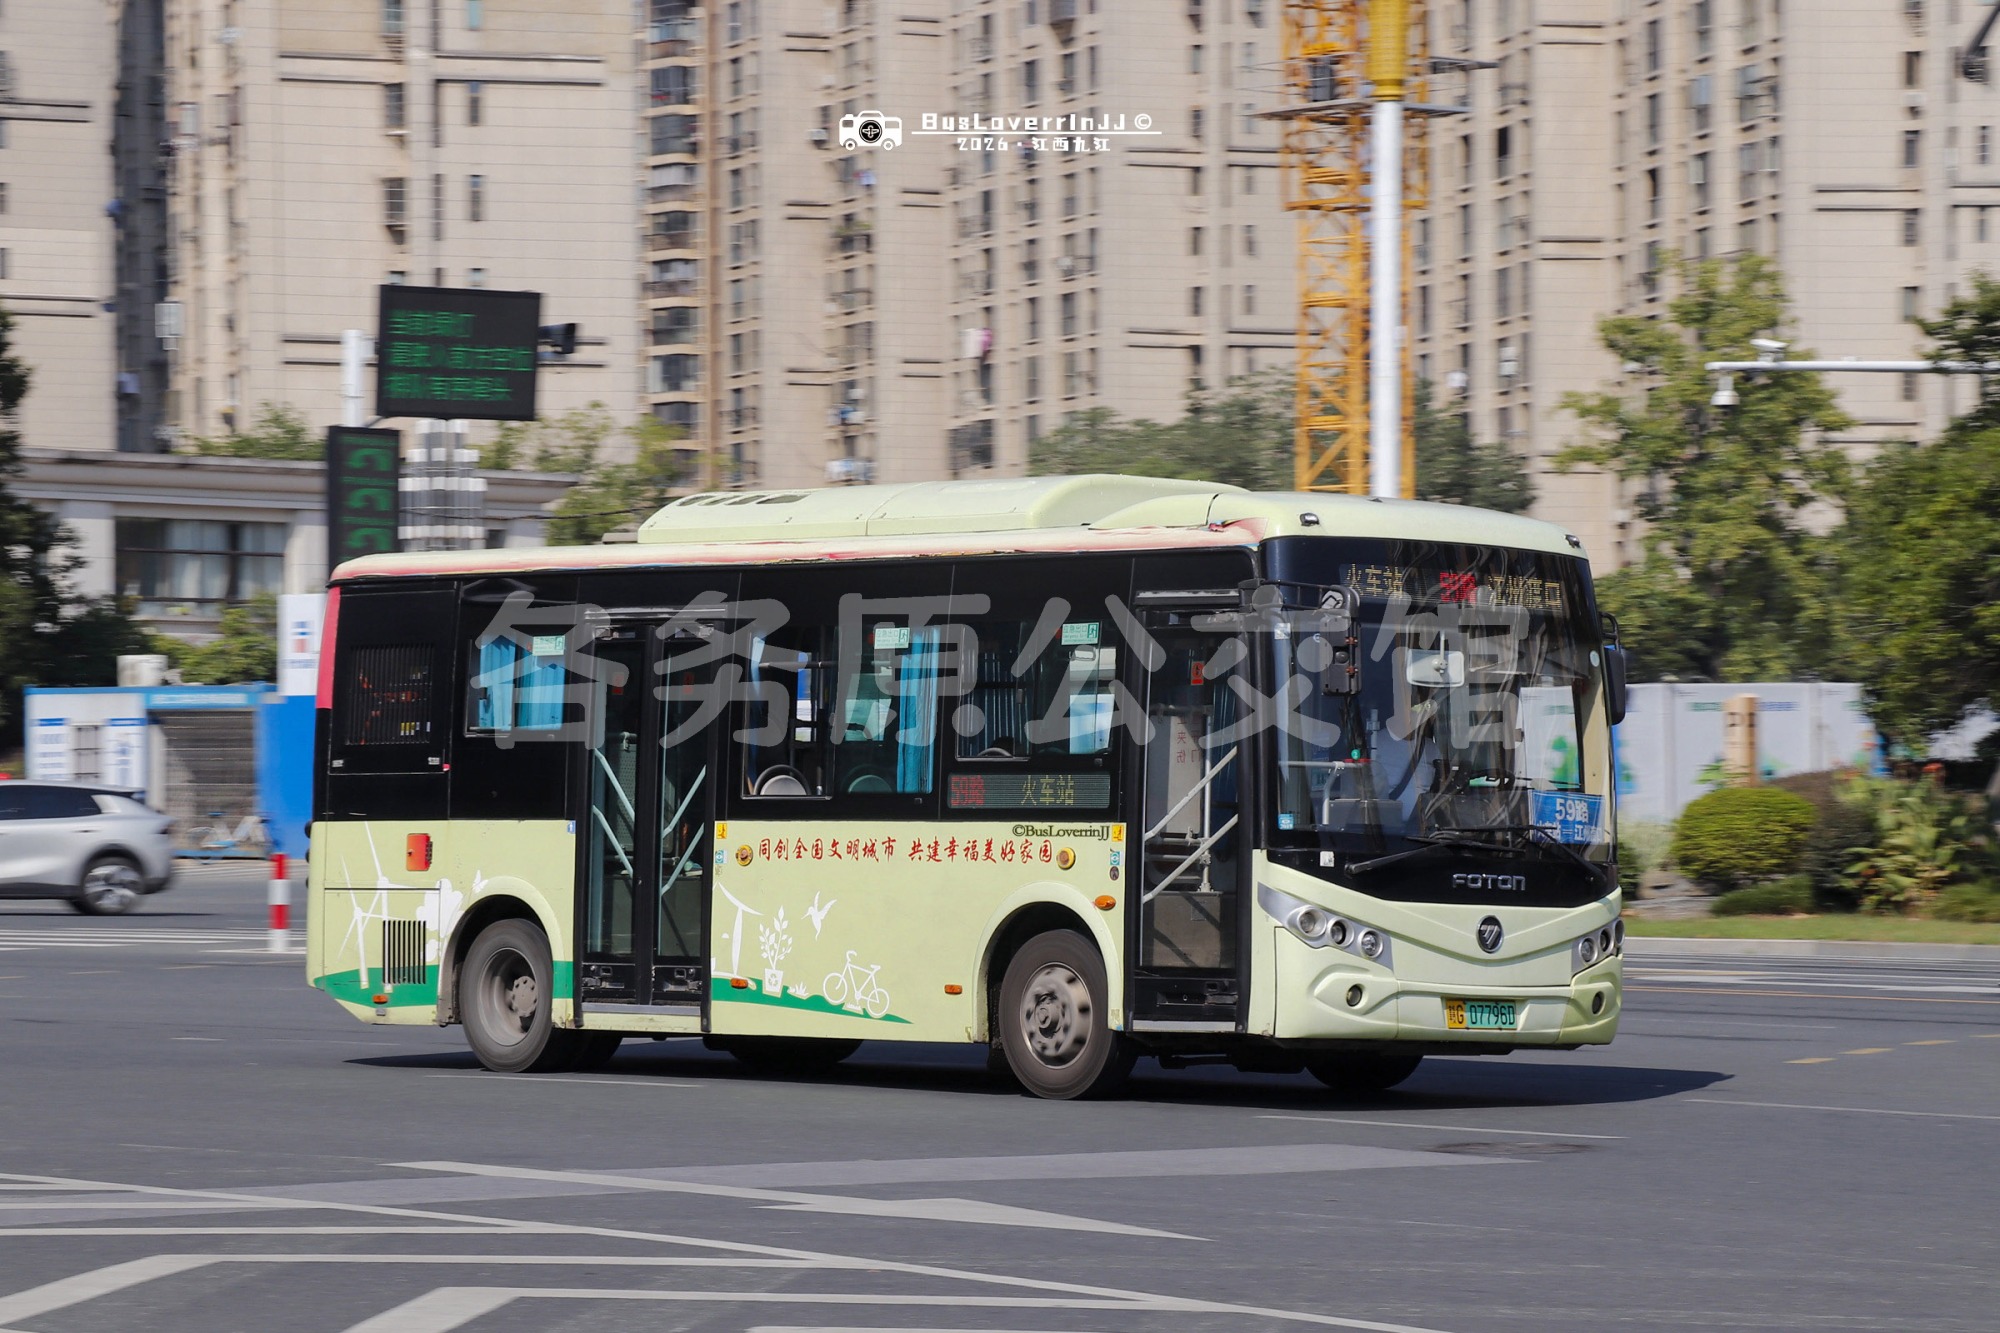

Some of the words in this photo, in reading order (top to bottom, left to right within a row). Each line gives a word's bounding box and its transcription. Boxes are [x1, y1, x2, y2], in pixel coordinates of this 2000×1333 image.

[1346, 563, 1402, 597] 火车站
[1488, 576, 1561, 609] 江州渡口
[951, 775, 985, 806] 59路
[1021, 775, 1074, 806] 火车站
[1555, 798, 1589, 823] 59路
[758, 836, 897, 863] 同创全国文明城市
[908, 835, 1053, 864] 共建幸福美好家园
